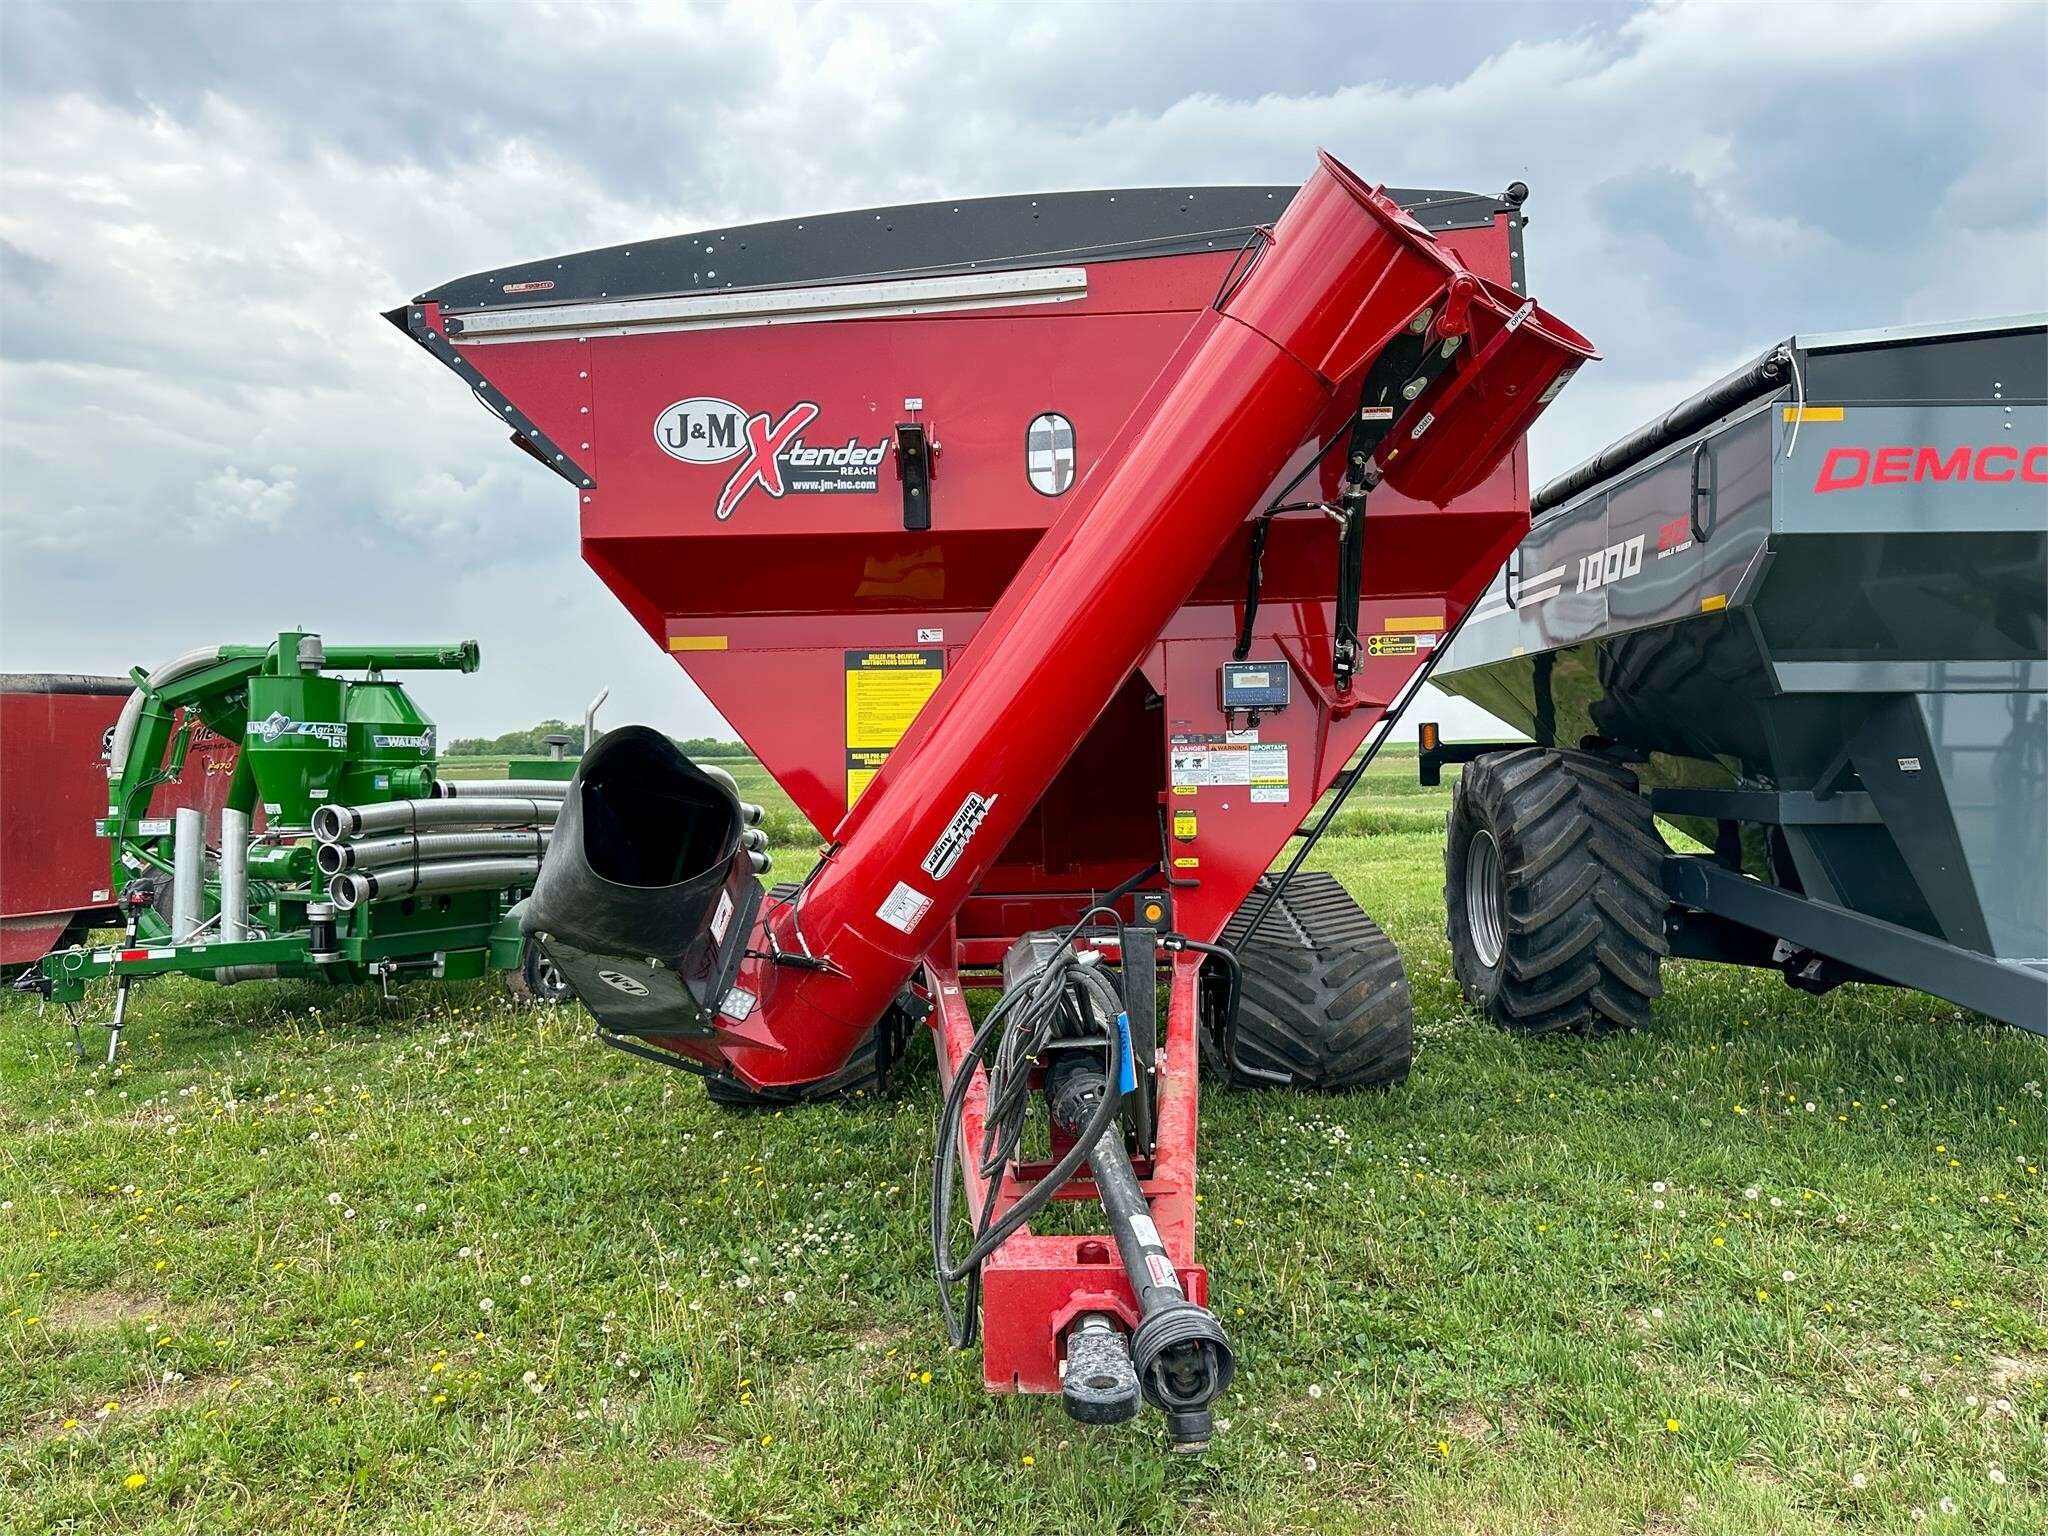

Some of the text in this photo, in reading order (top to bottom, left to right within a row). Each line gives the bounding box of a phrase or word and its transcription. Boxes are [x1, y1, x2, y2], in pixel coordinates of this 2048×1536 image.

[1510, 309, 1527, 327] OPEN
[664, 413, 737, 449] J&M
[1413, 415, 1433, 437] CLOSED
[840, 466, 877, 476] REACH
[1813, 446, 2048, 494] DEMCO
[792, 480, 876, 491] www.jm-inc.com
[1576, 534, 1645, 594] 1000
[388, 736, 430, 748] WALINGA
[1251, 743, 1287, 751] IMPORTANT
[928, 797, 979, 869] Bullet Auger
[905, 904, 927, 932] DANGER
